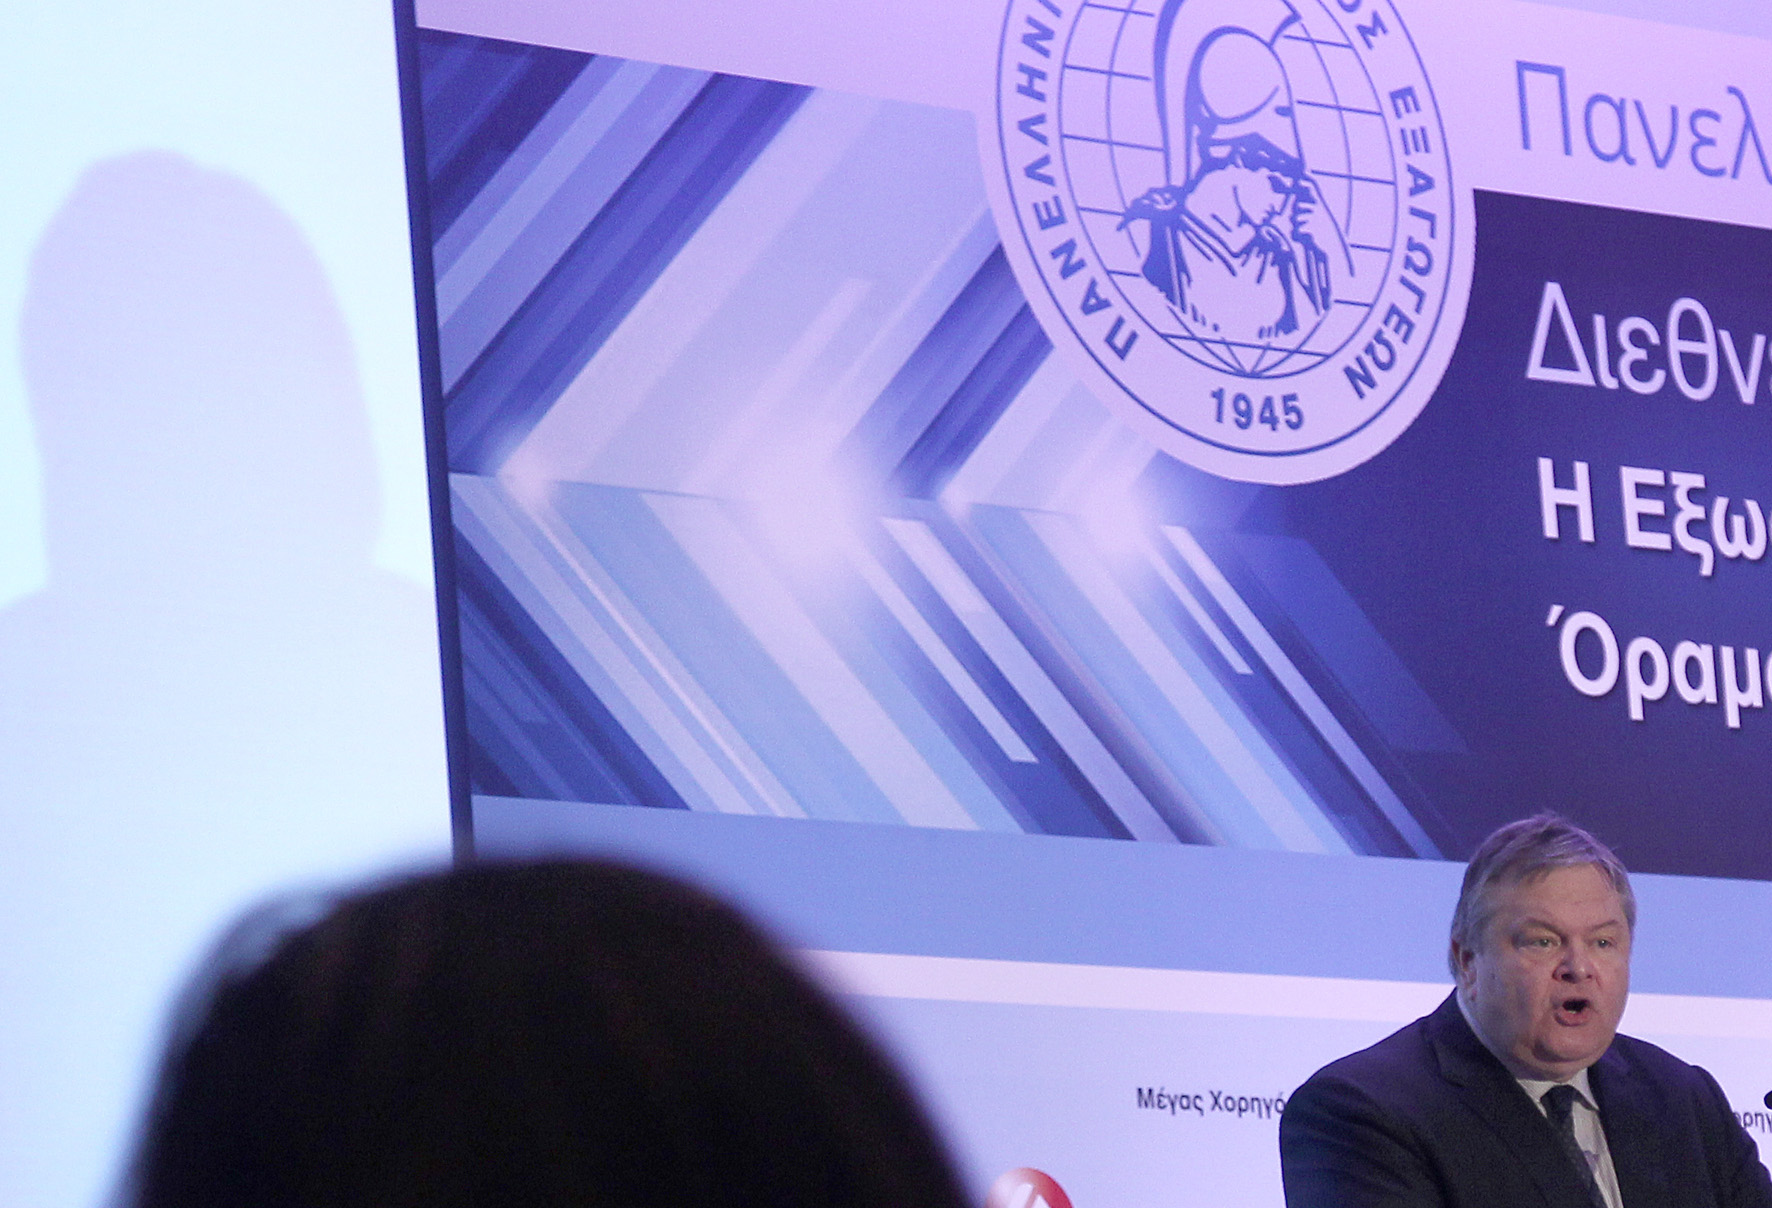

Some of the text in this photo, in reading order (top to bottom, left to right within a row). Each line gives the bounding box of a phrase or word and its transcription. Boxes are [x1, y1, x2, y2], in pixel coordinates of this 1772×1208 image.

[1016, 0, 1139, 361] ΠΑΝΕΛΛΗΝΙ
[1343, 86, 1438, 399] ΕΞΑΓΩΓΕΩΝ
[1209, 387, 1304, 431] 1945
[1537, 456, 1596, 543] Η
[1137, 1086, 1286, 1119] Μέγας Χορηγό
